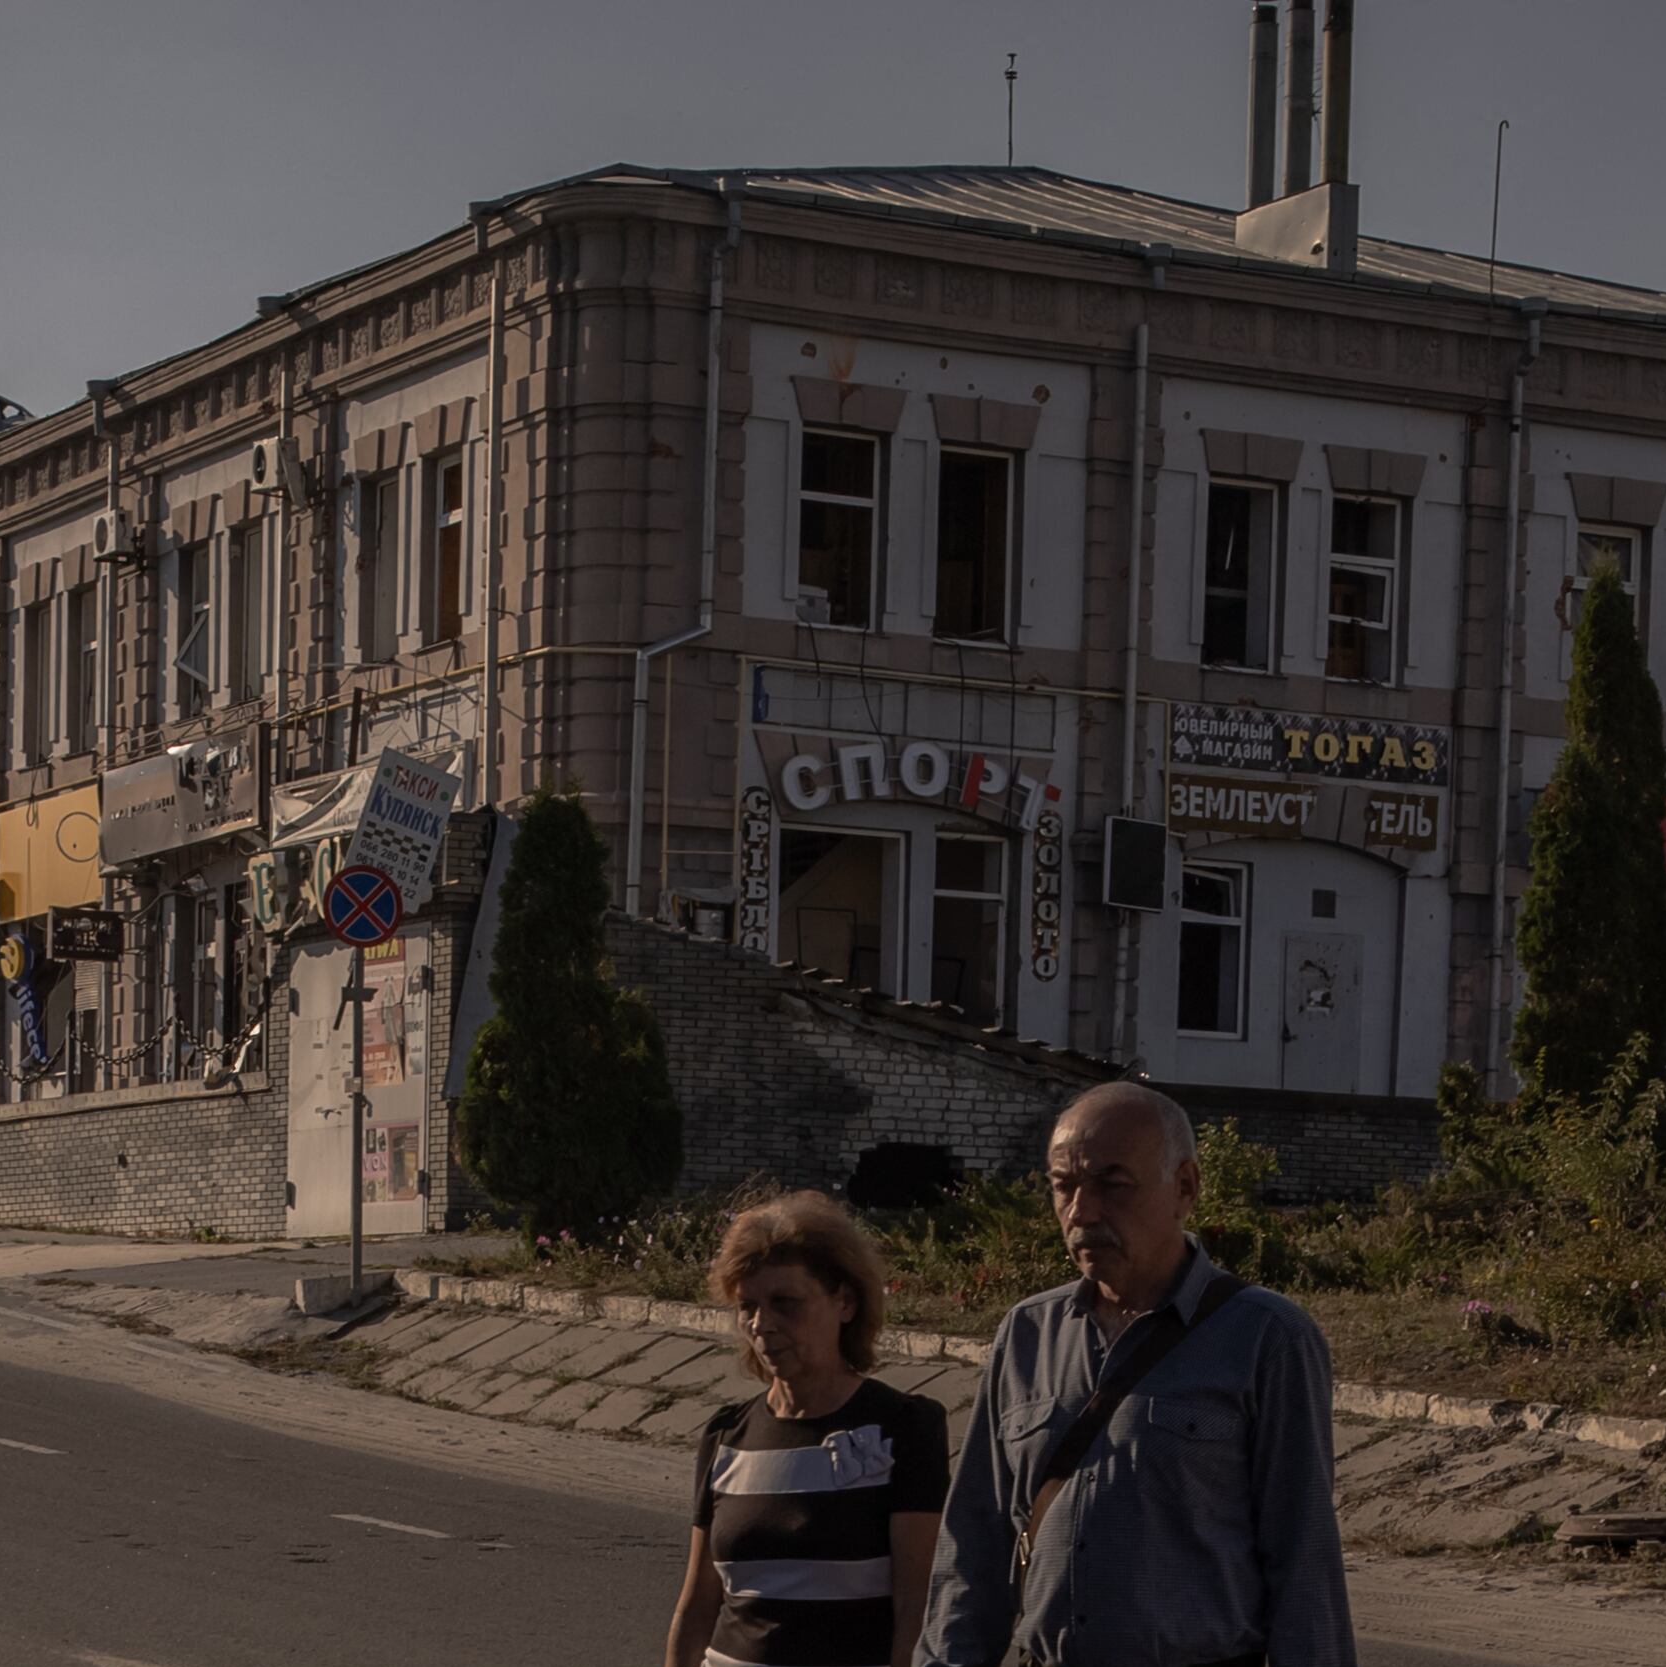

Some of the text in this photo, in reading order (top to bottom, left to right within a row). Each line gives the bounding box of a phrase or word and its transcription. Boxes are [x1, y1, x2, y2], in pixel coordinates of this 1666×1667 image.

[1173, 716, 1274, 741] ЮВЕЛИРНЫЙ
[1201, 738, 1274, 761] МАГАЗИН
[392, 764, 440, 801] ТАКСИ
[781, 741, 1061, 832] СПОРТ
[1170, 784, 1433, 838] ЗЕМЛЕУСТТЕЛЬ
[360, 839, 426, 873] 066 280 11 90
[743, 790, 770, 951] СРІБЛО
[397, 869, 408, 882] 10
[409, 875, 420, 887] 14
[404, 888, 417, 900] 22
[1036, 814, 1061, 977] ЗОЛОТО
[16, 984, 48, 1064] lifece
